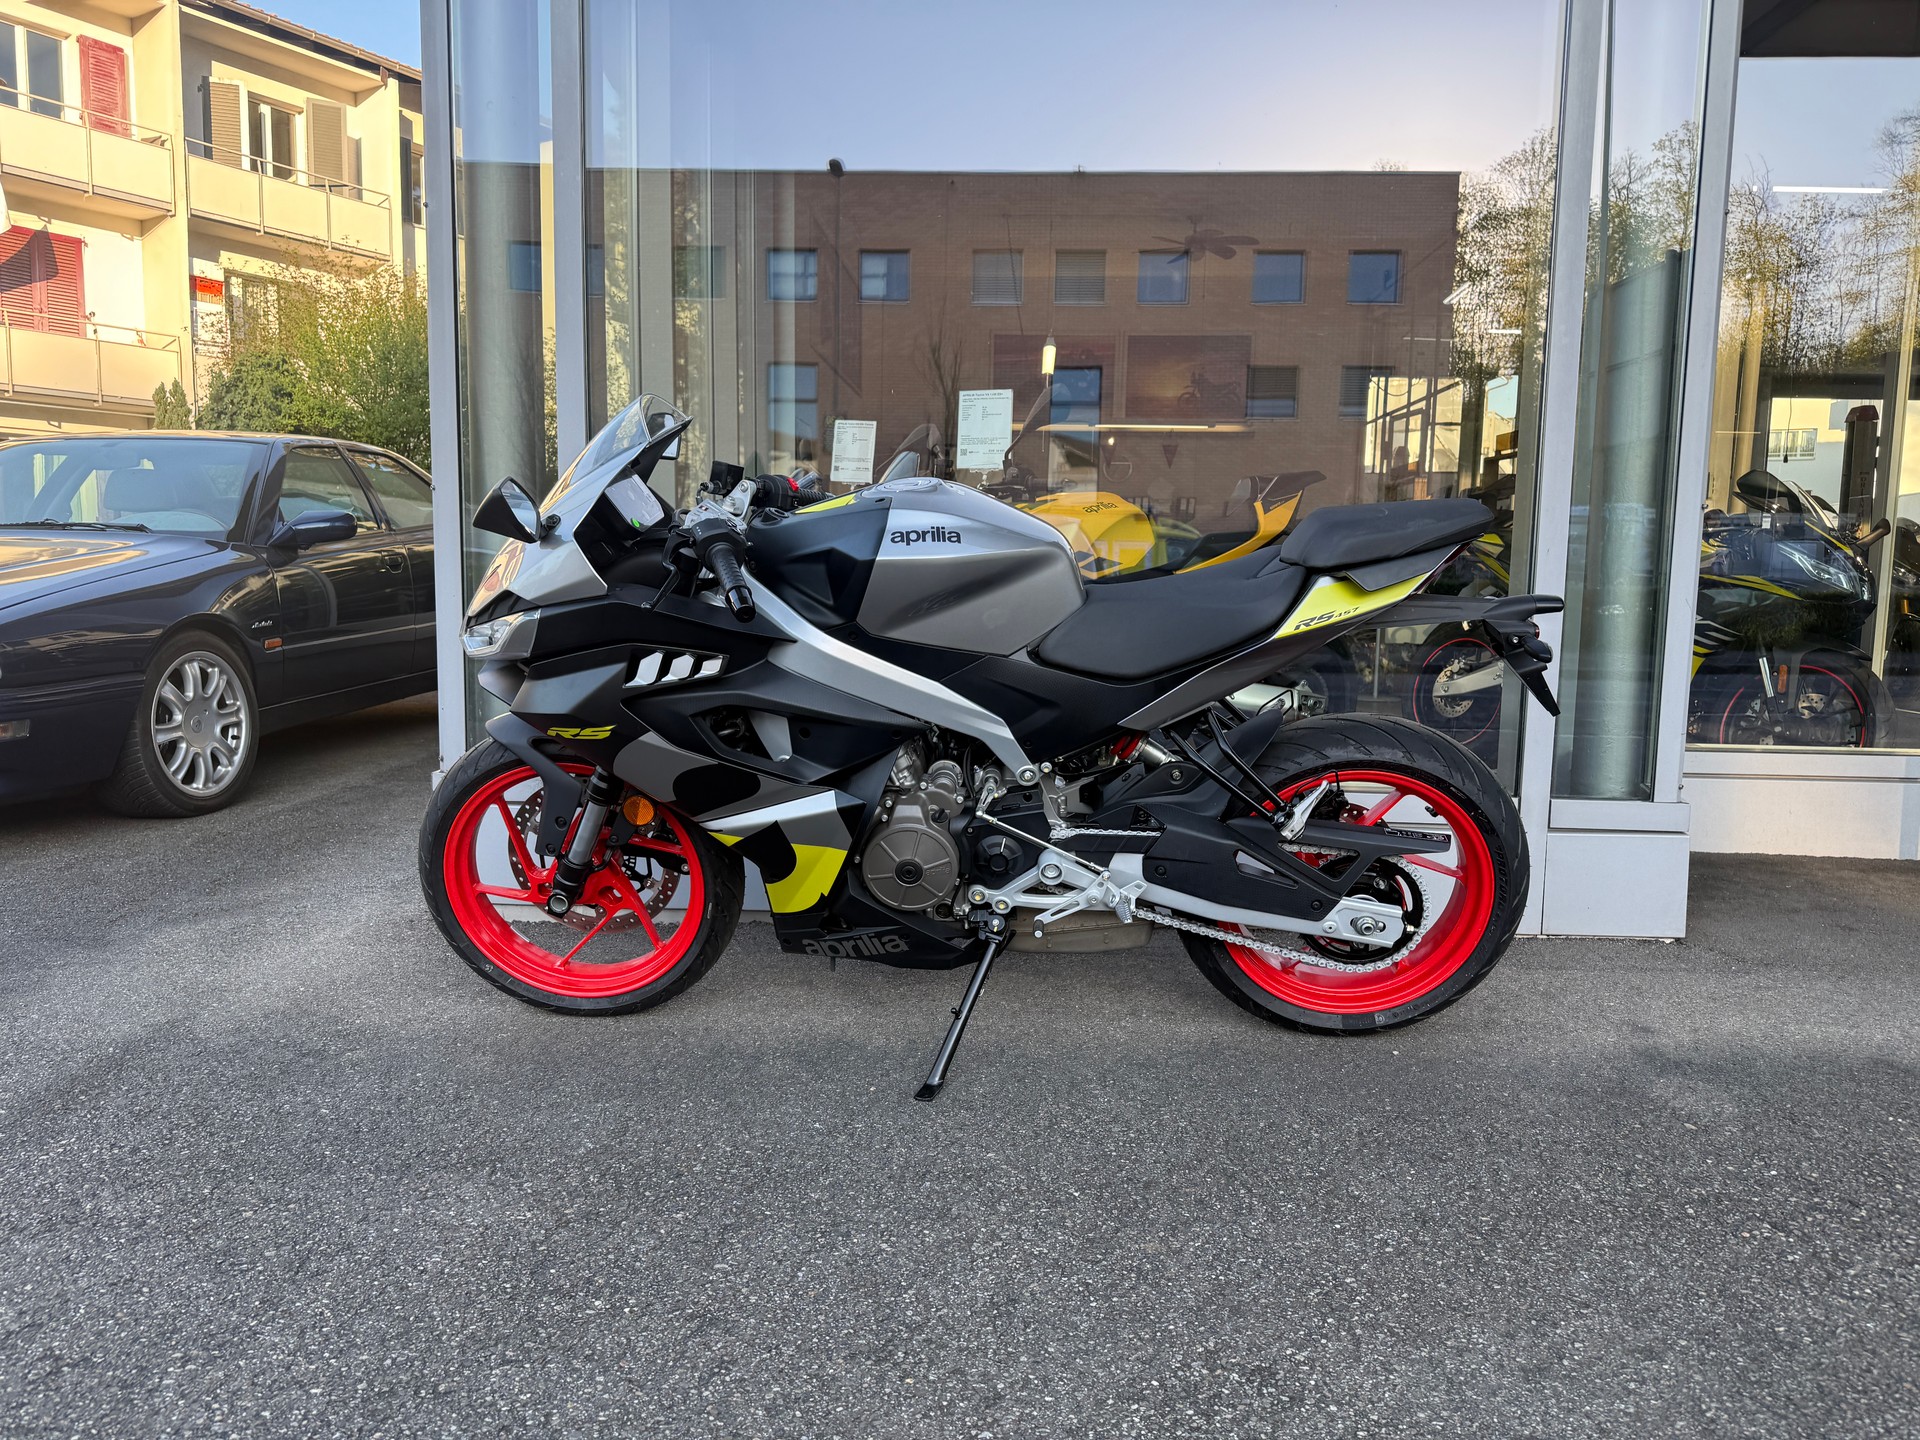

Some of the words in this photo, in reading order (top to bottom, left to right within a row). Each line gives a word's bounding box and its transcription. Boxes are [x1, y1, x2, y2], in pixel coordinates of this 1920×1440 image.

[1082, 501, 1119, 514] aprilia
[890, 526, 962, 546] aprilia
[1294, 610, 1336, 631] RS
[547, 724, 617, 740] RS
[802, 933, 910, 958] aprilia
